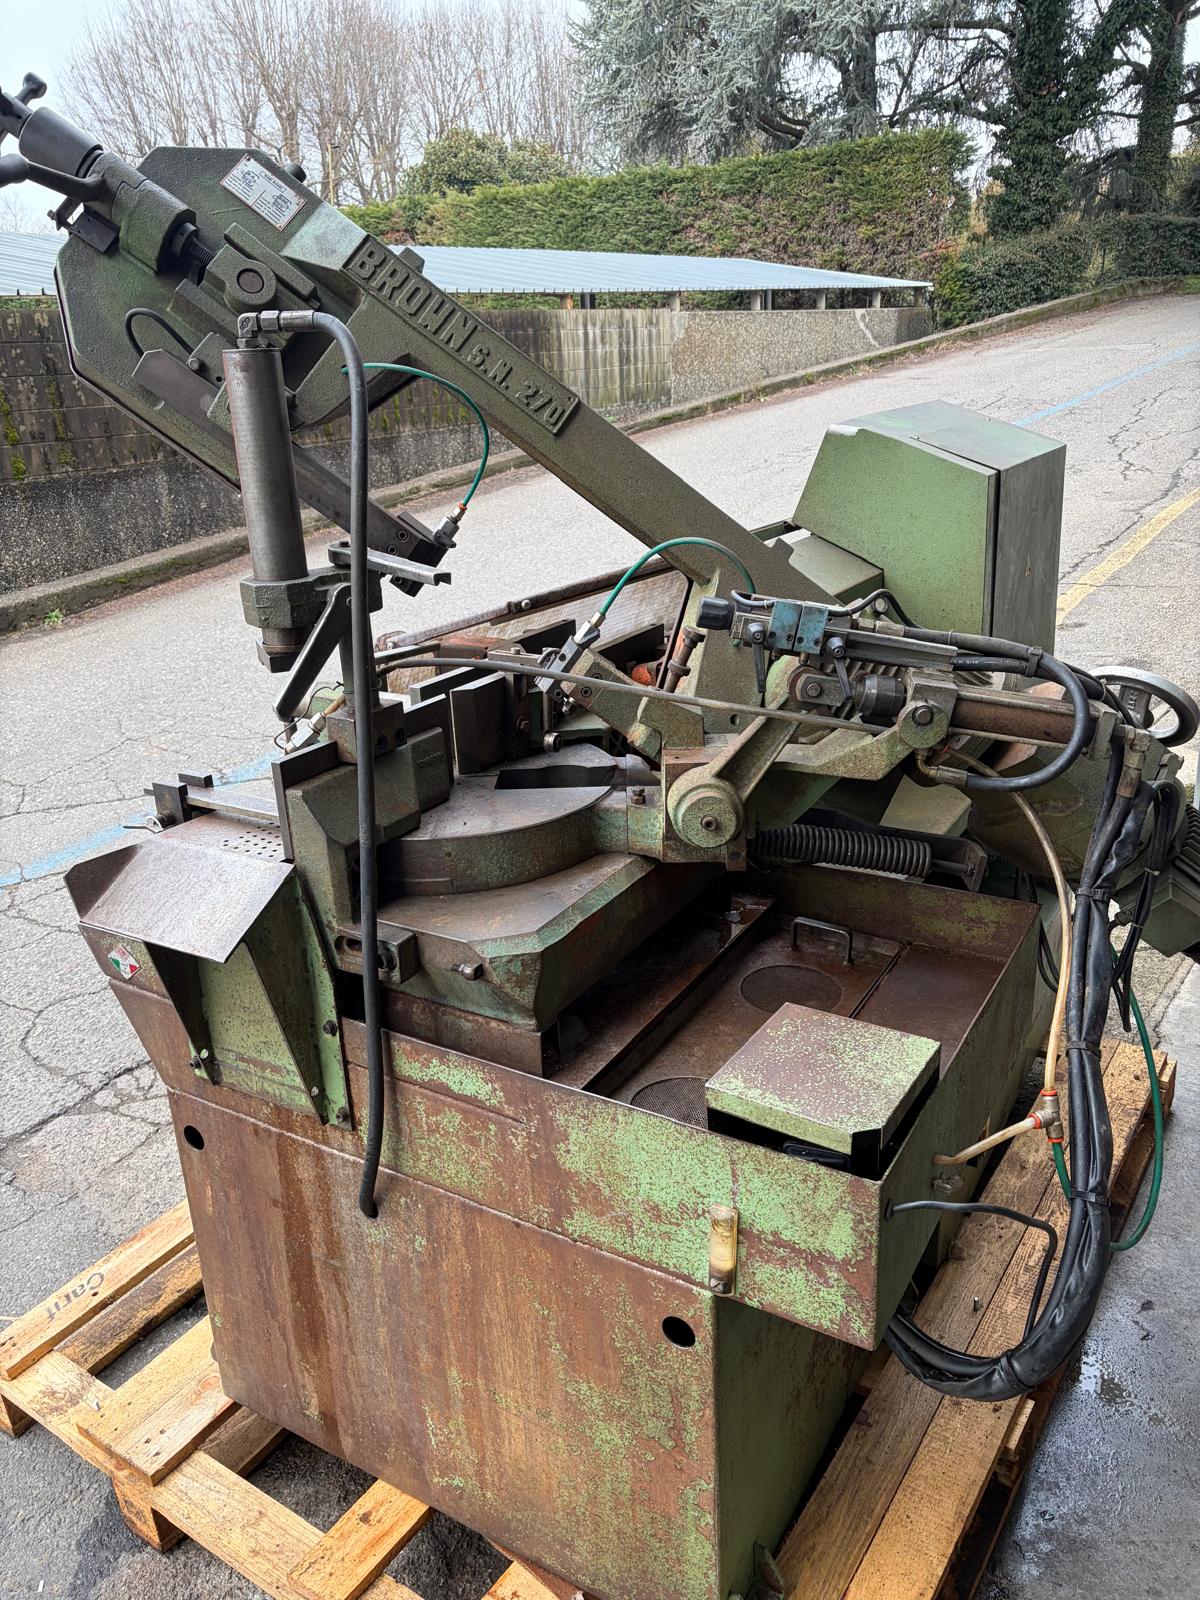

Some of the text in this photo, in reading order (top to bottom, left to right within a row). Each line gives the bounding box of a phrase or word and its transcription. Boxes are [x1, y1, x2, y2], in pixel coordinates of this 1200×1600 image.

[350, 243, 566, 426] BROWN S.N. 270
